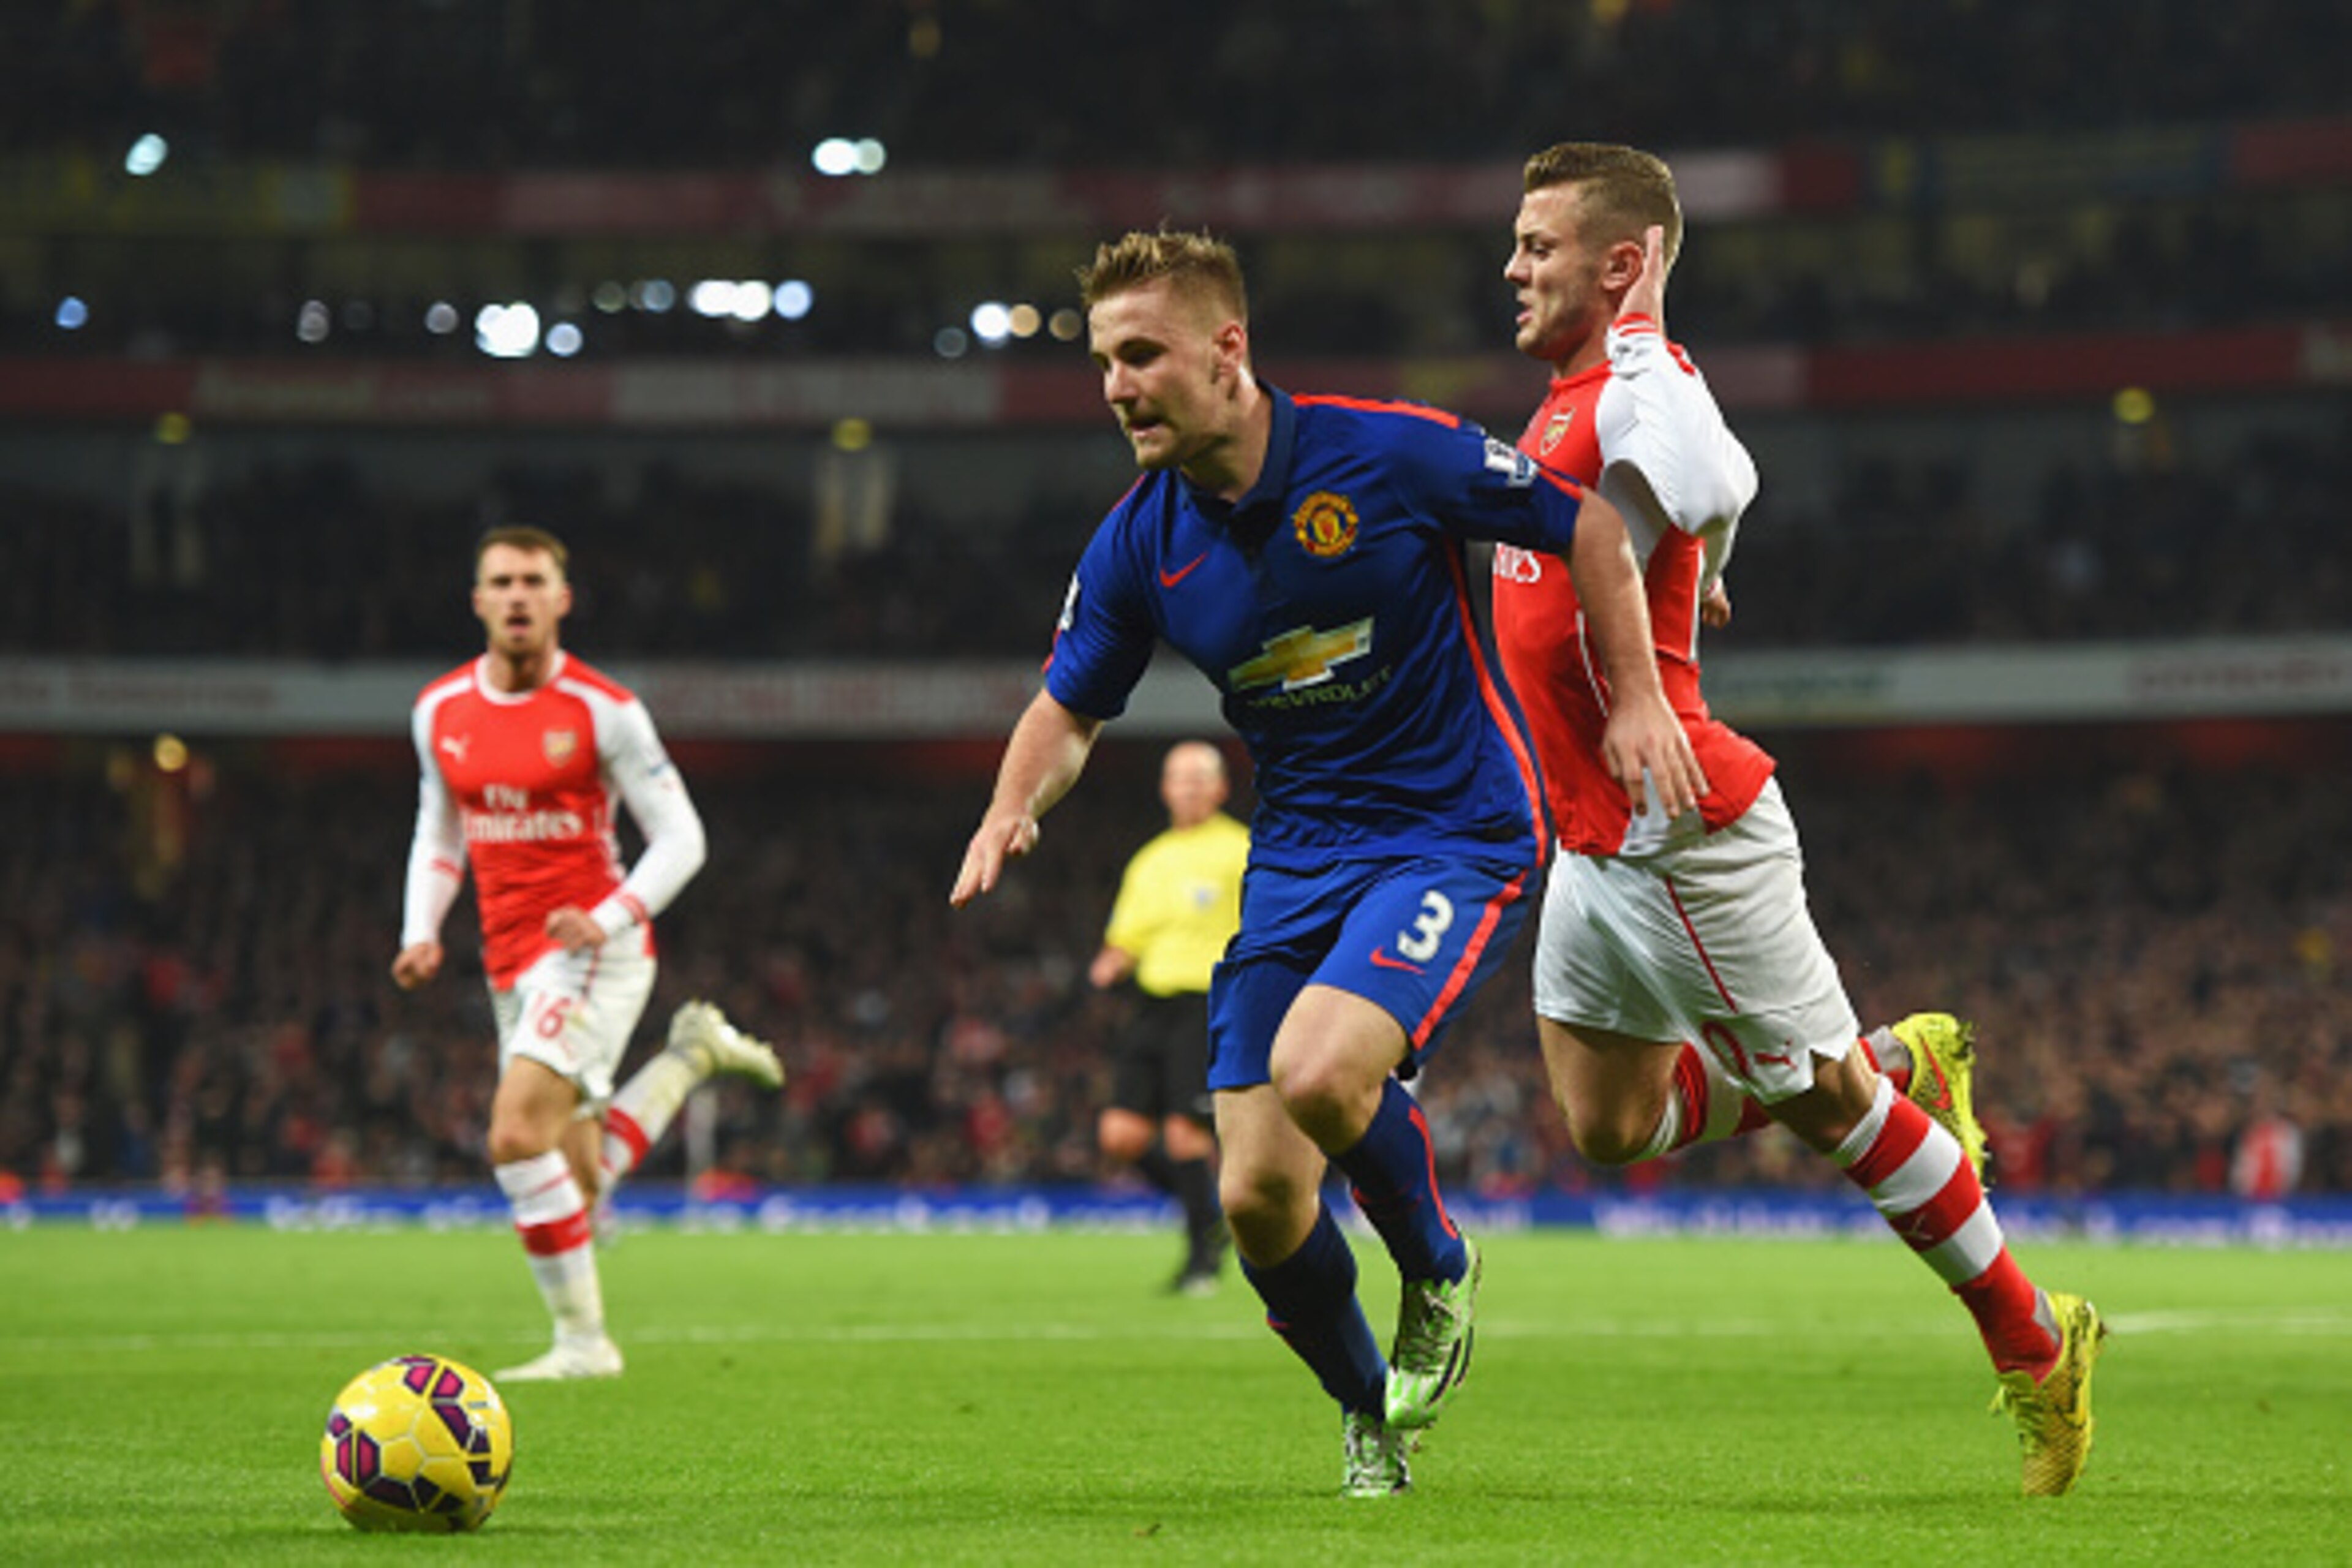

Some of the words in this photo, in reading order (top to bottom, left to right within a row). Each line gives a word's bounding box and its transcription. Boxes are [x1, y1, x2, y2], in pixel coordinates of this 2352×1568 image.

[462, 807, 583, 843] Emirates
[1397, 889, 1455, 963] 3
[529, 989, 571, 1040] 16
